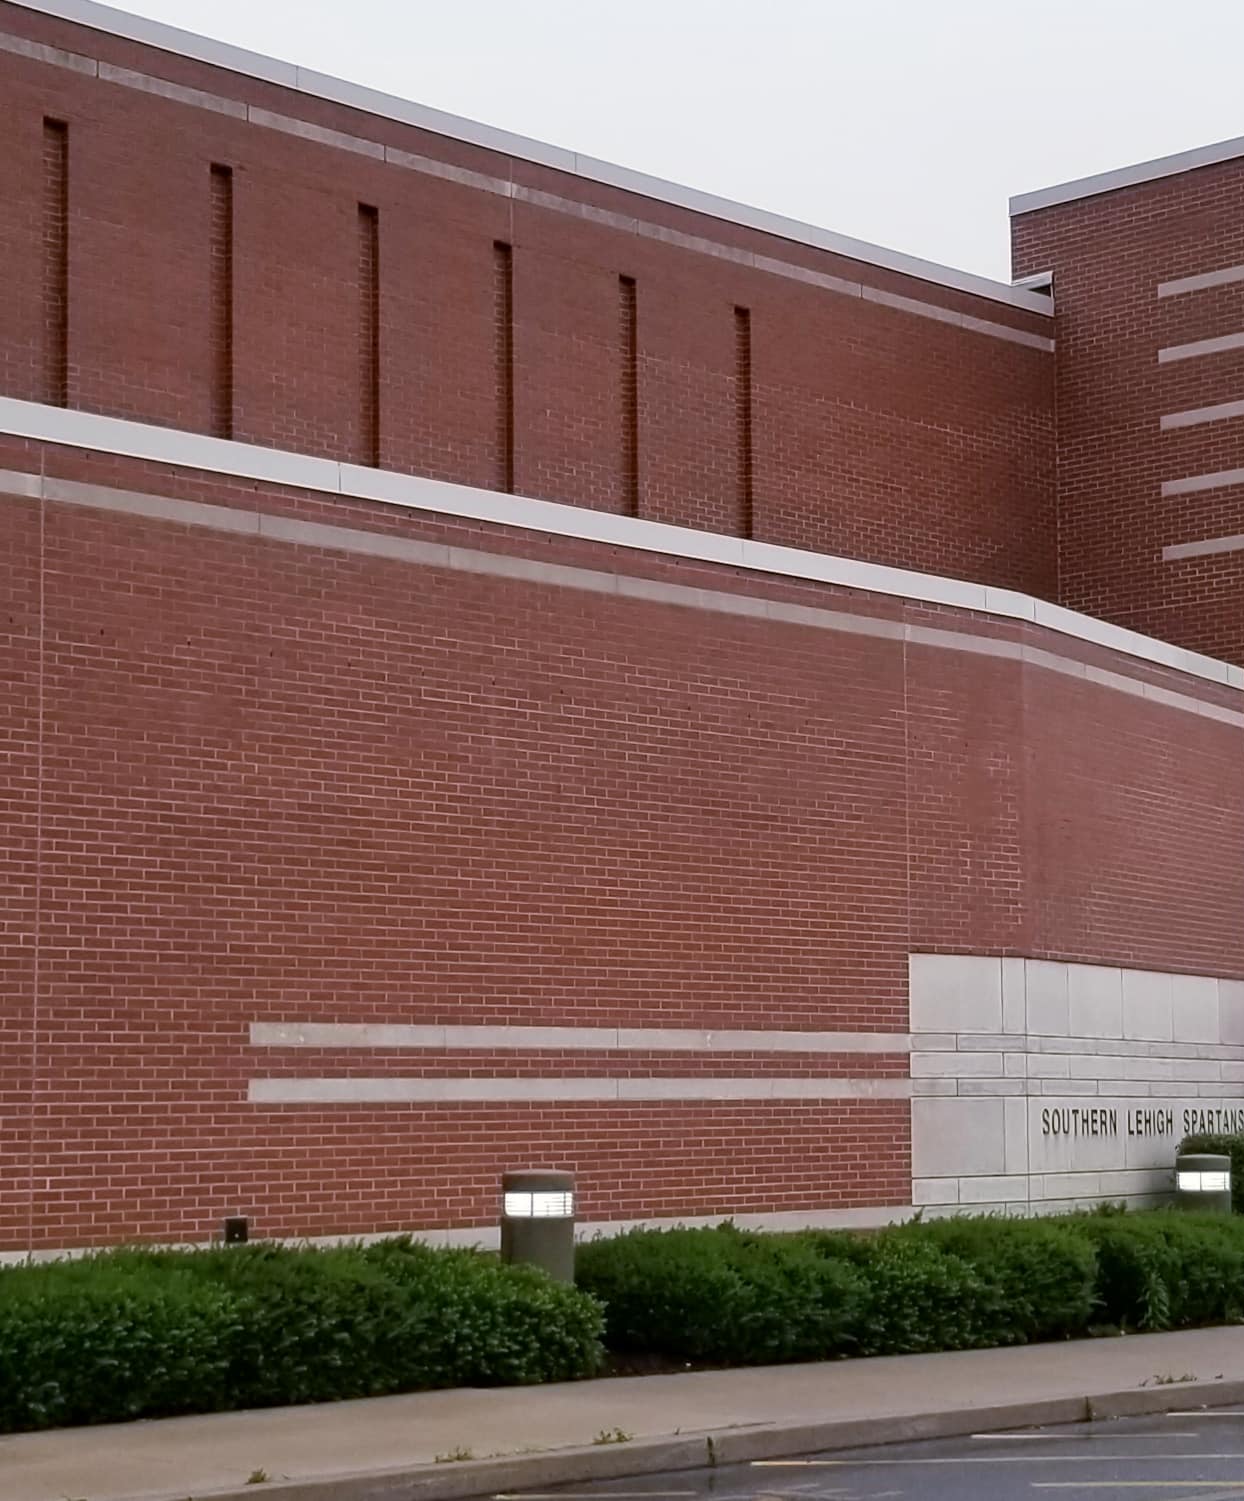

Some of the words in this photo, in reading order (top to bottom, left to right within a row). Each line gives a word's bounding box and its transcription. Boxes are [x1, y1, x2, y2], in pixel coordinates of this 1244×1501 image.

[1041, 1108, 1117, 1135] SOUTHERN
[1127, 1109, 1173, 1136] LEHIGH
[1183, 1109, 1244, 1134] SPARTANS
